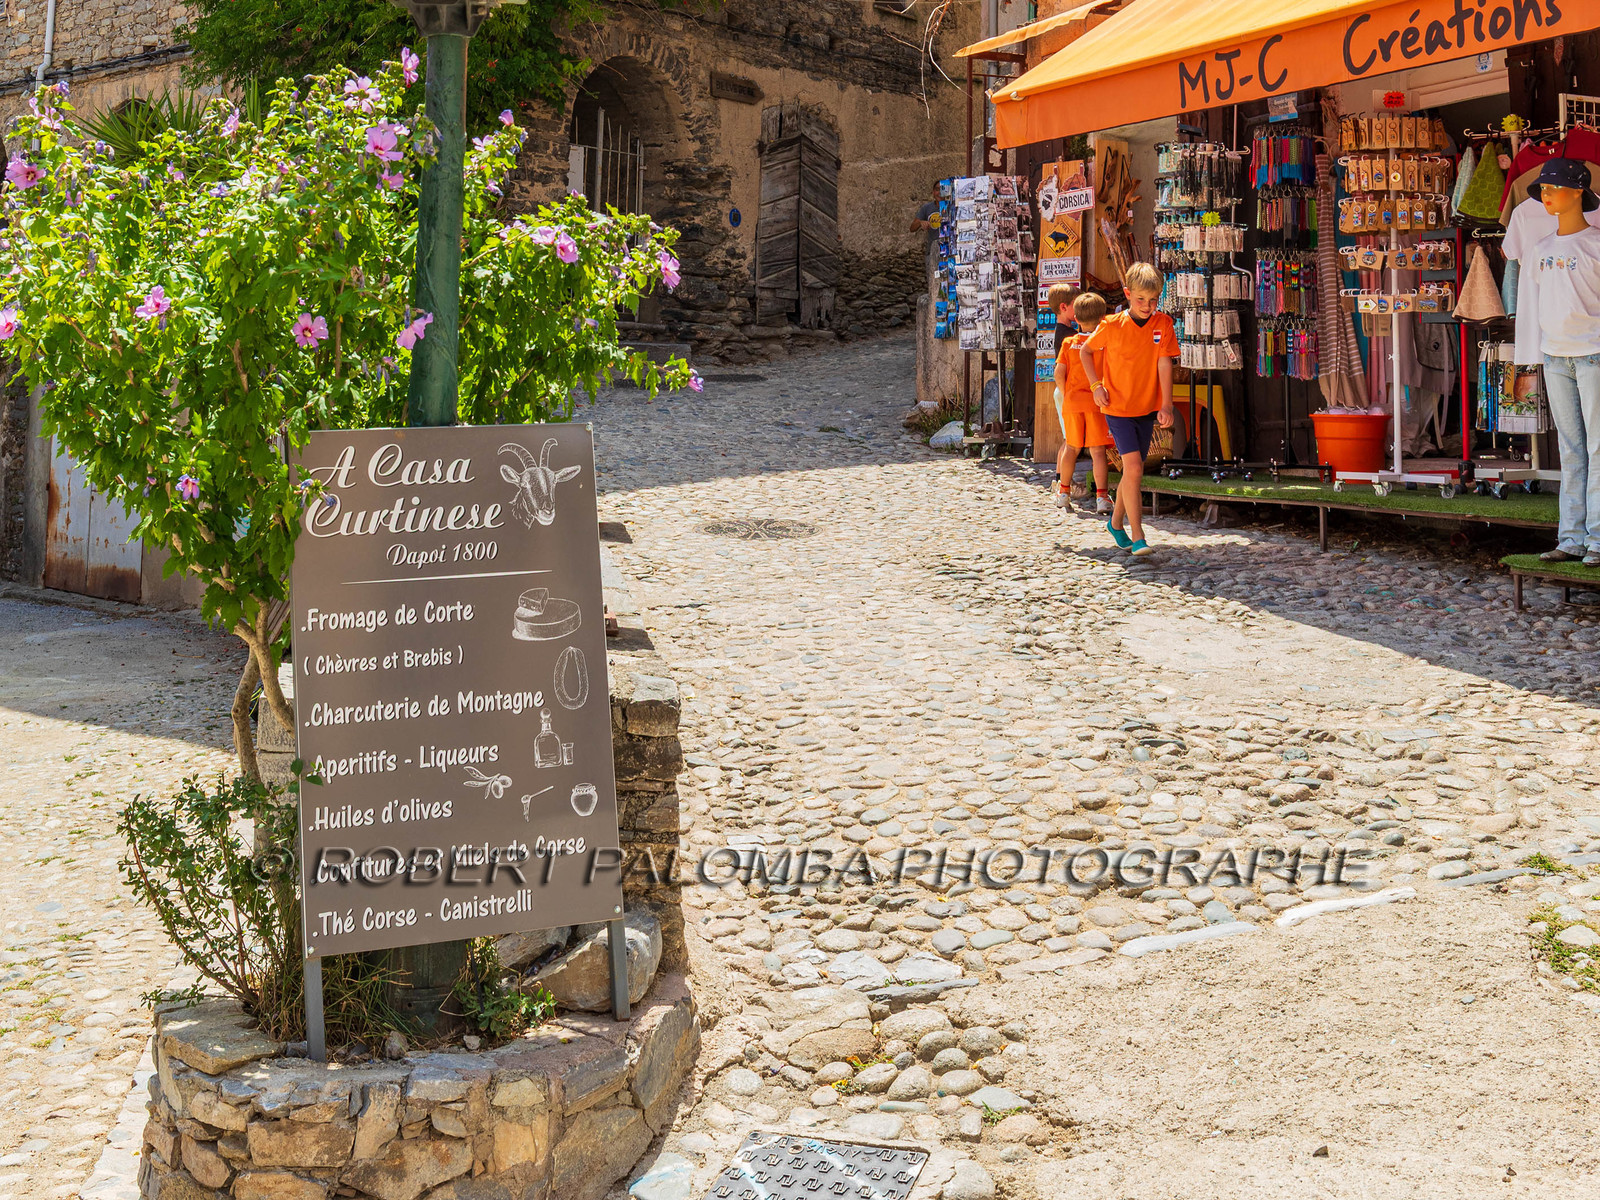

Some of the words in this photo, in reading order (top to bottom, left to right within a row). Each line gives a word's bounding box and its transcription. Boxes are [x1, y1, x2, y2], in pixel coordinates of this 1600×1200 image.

[1179, 34, 1288, 108] MJ-C
[1059, 193, 1090, 209] CORSICA
[309, 445, 356, 488] A
[368, 443, 475, 487] Casa
[305, 494, 505, 538] Curtinese
[386, 542, 446, 569] Dapoi
[453, 541, 499, 562] 1800
[395, 604, 418, 625] de
[424, 600, 475, 624] Corte
[315, 652, 377, 675] Chèvres
[382, 650, 400, 670] et
[403, 647, 452, 669] Brebis
[427, 695, 450, 717] de
[457, 690, 545, 715] Montagne
[419, 744, 499, 773] Liqueurs
[381, 799, 453, 824] d'olives
[424, 848, 444, 871] et
[451, 841, 501, 868] Miels
[507, 839, 530, 862] de
[535, 835, 587, 859] Corse
[362, 906, 418, 931] Corse
[440, 889, 533, 922] Canistrelli
